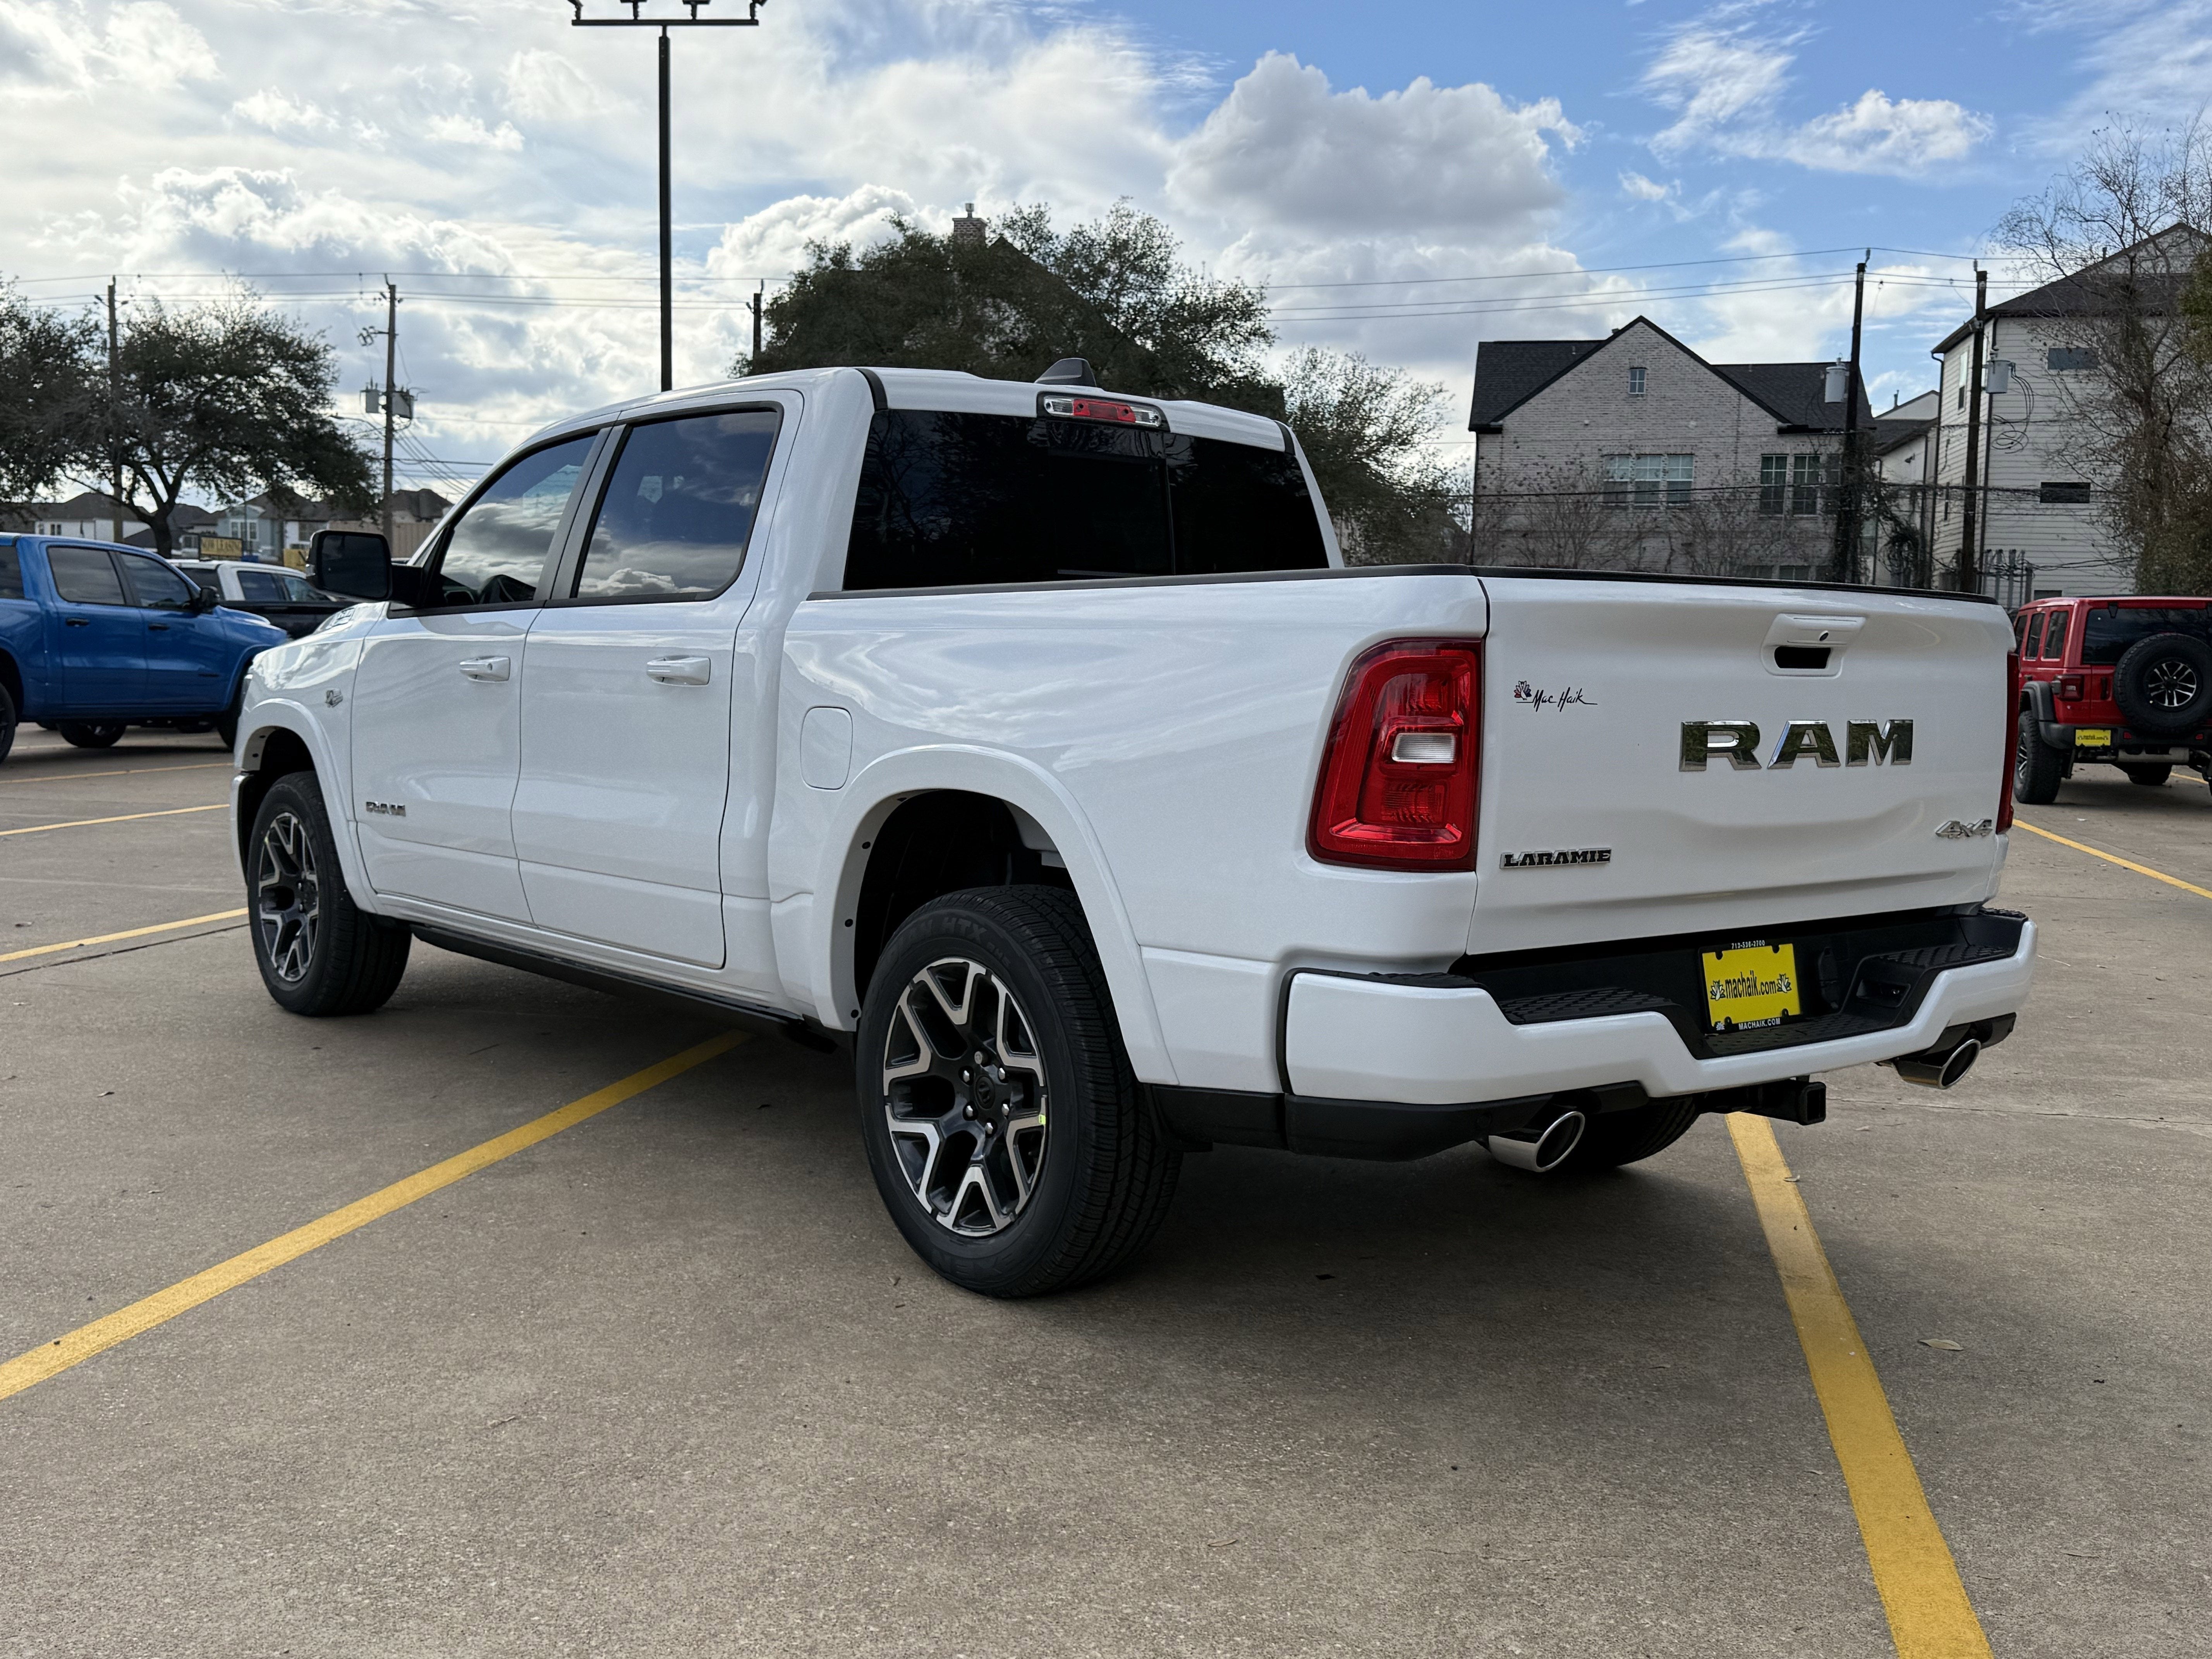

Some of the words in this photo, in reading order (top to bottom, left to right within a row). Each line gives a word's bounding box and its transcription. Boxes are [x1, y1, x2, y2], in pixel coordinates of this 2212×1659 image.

[1532, 689, 1557, 712] Mac
[1558, 687, 1598, 712] Haik
[1679, 719, 1913, 772] RAM
[366, 801, 406, 817] RAM
[1501, 848, 1612, 868] LARAMIE
[1725, 970, 1778, 999] machaik.com
[1738, 1018, 1781, 1030] MACHAIK.COM
